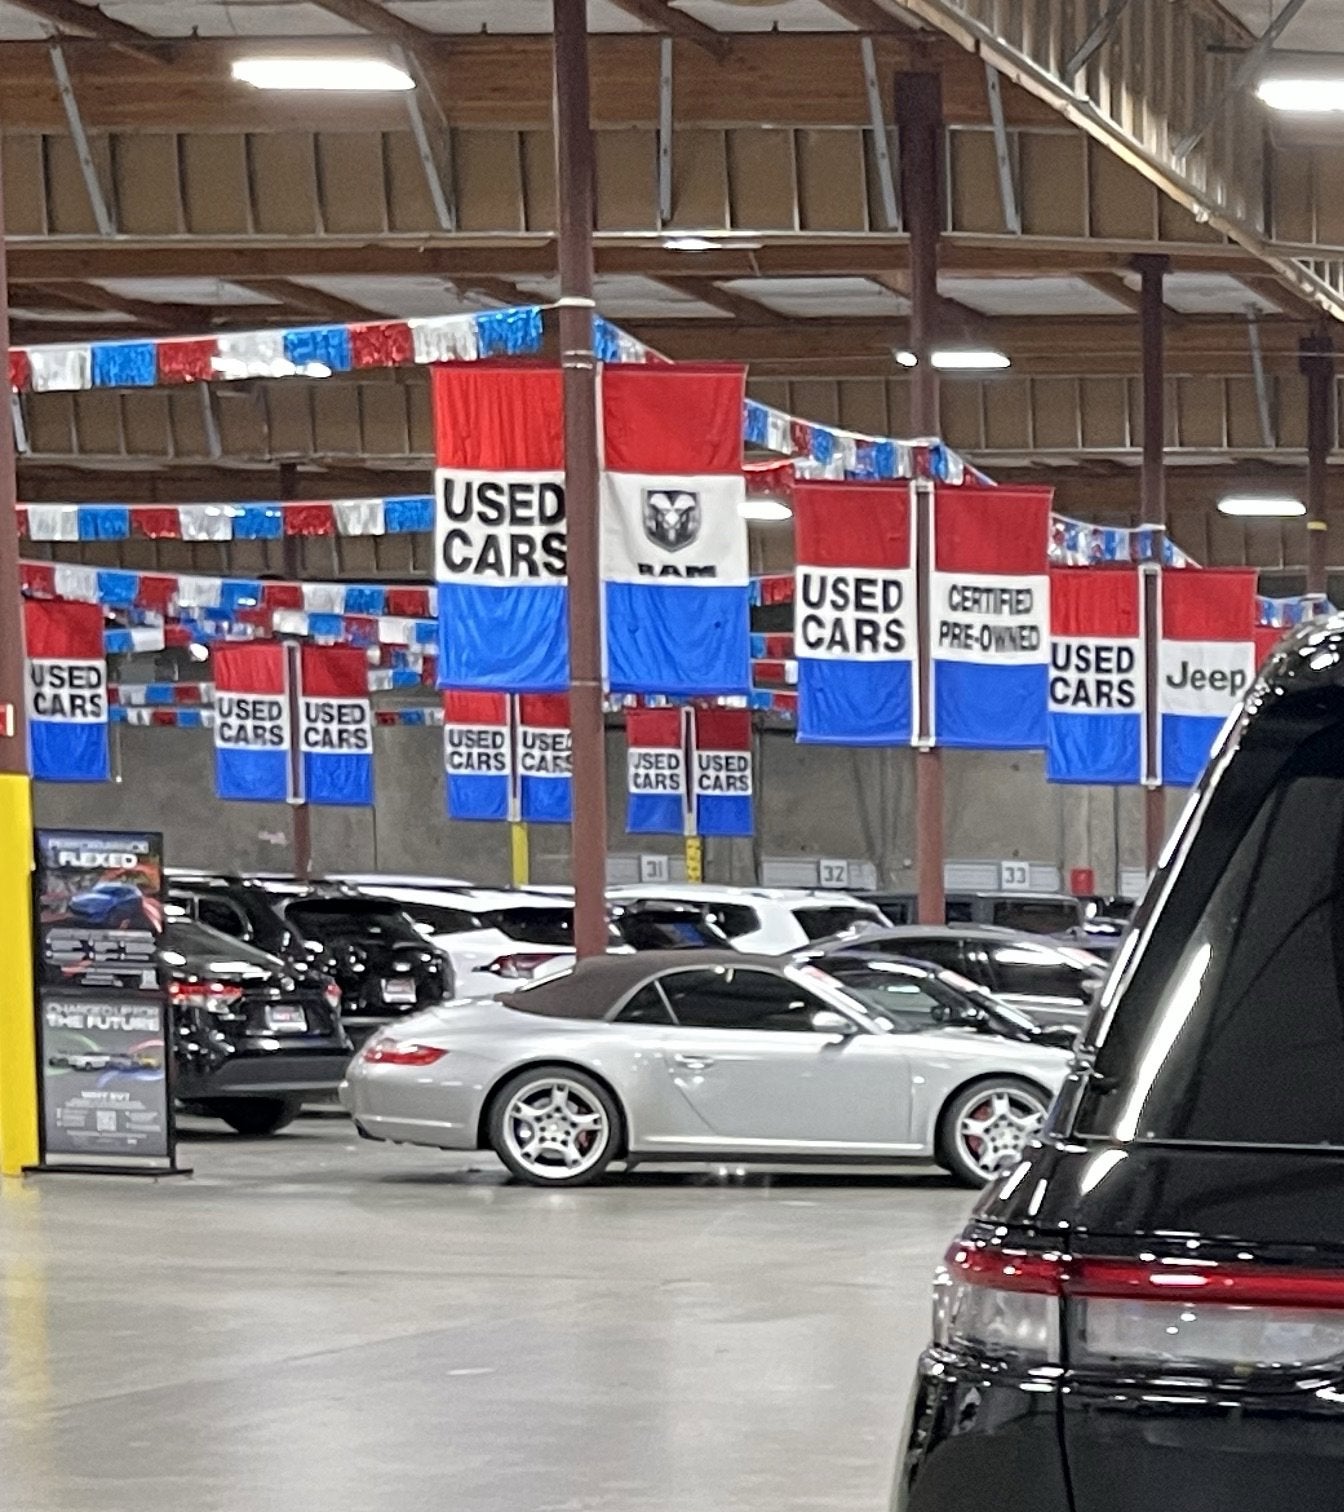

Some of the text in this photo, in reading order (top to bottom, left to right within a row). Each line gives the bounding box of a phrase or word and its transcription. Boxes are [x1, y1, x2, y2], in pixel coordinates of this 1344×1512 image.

[443, 478, 567, 528] USED
[442, 528, 568, 578] CARS
[637, 562, 718, 578] RAM
[802, 573, 904, 614] USED
[948, 583, 1034, 616] CERTIFIED
[801, 613, 906, 653] CARS
[938, 620, 1041, 653] PRE-OWNED
[1051, 642, 1135, 674] USED
[30, 662, 102, 689] USED
[1165, 661, 1247, 697] Jeep
[1050, 676, 1136, 708] CARS
[33, 692, 102, 718] CARS
[218, 698, 283, 721] USED
[304, 702, 367, 726] USED
[219, 722, 285, 747] CARS
[304, 726, 369, 750] CARS
[449, 728, 505, 749] USED
[449, 751, 507, 772] CARS
[698, 754, 749, 772] USED
[633, 772, 681, 790] CARS
[698, 774, 750, 792] CARS
[646, 861, 663, 877] 31
[822, 864, 845, 883] 32
[1002, 866, 1027, 884] 33
